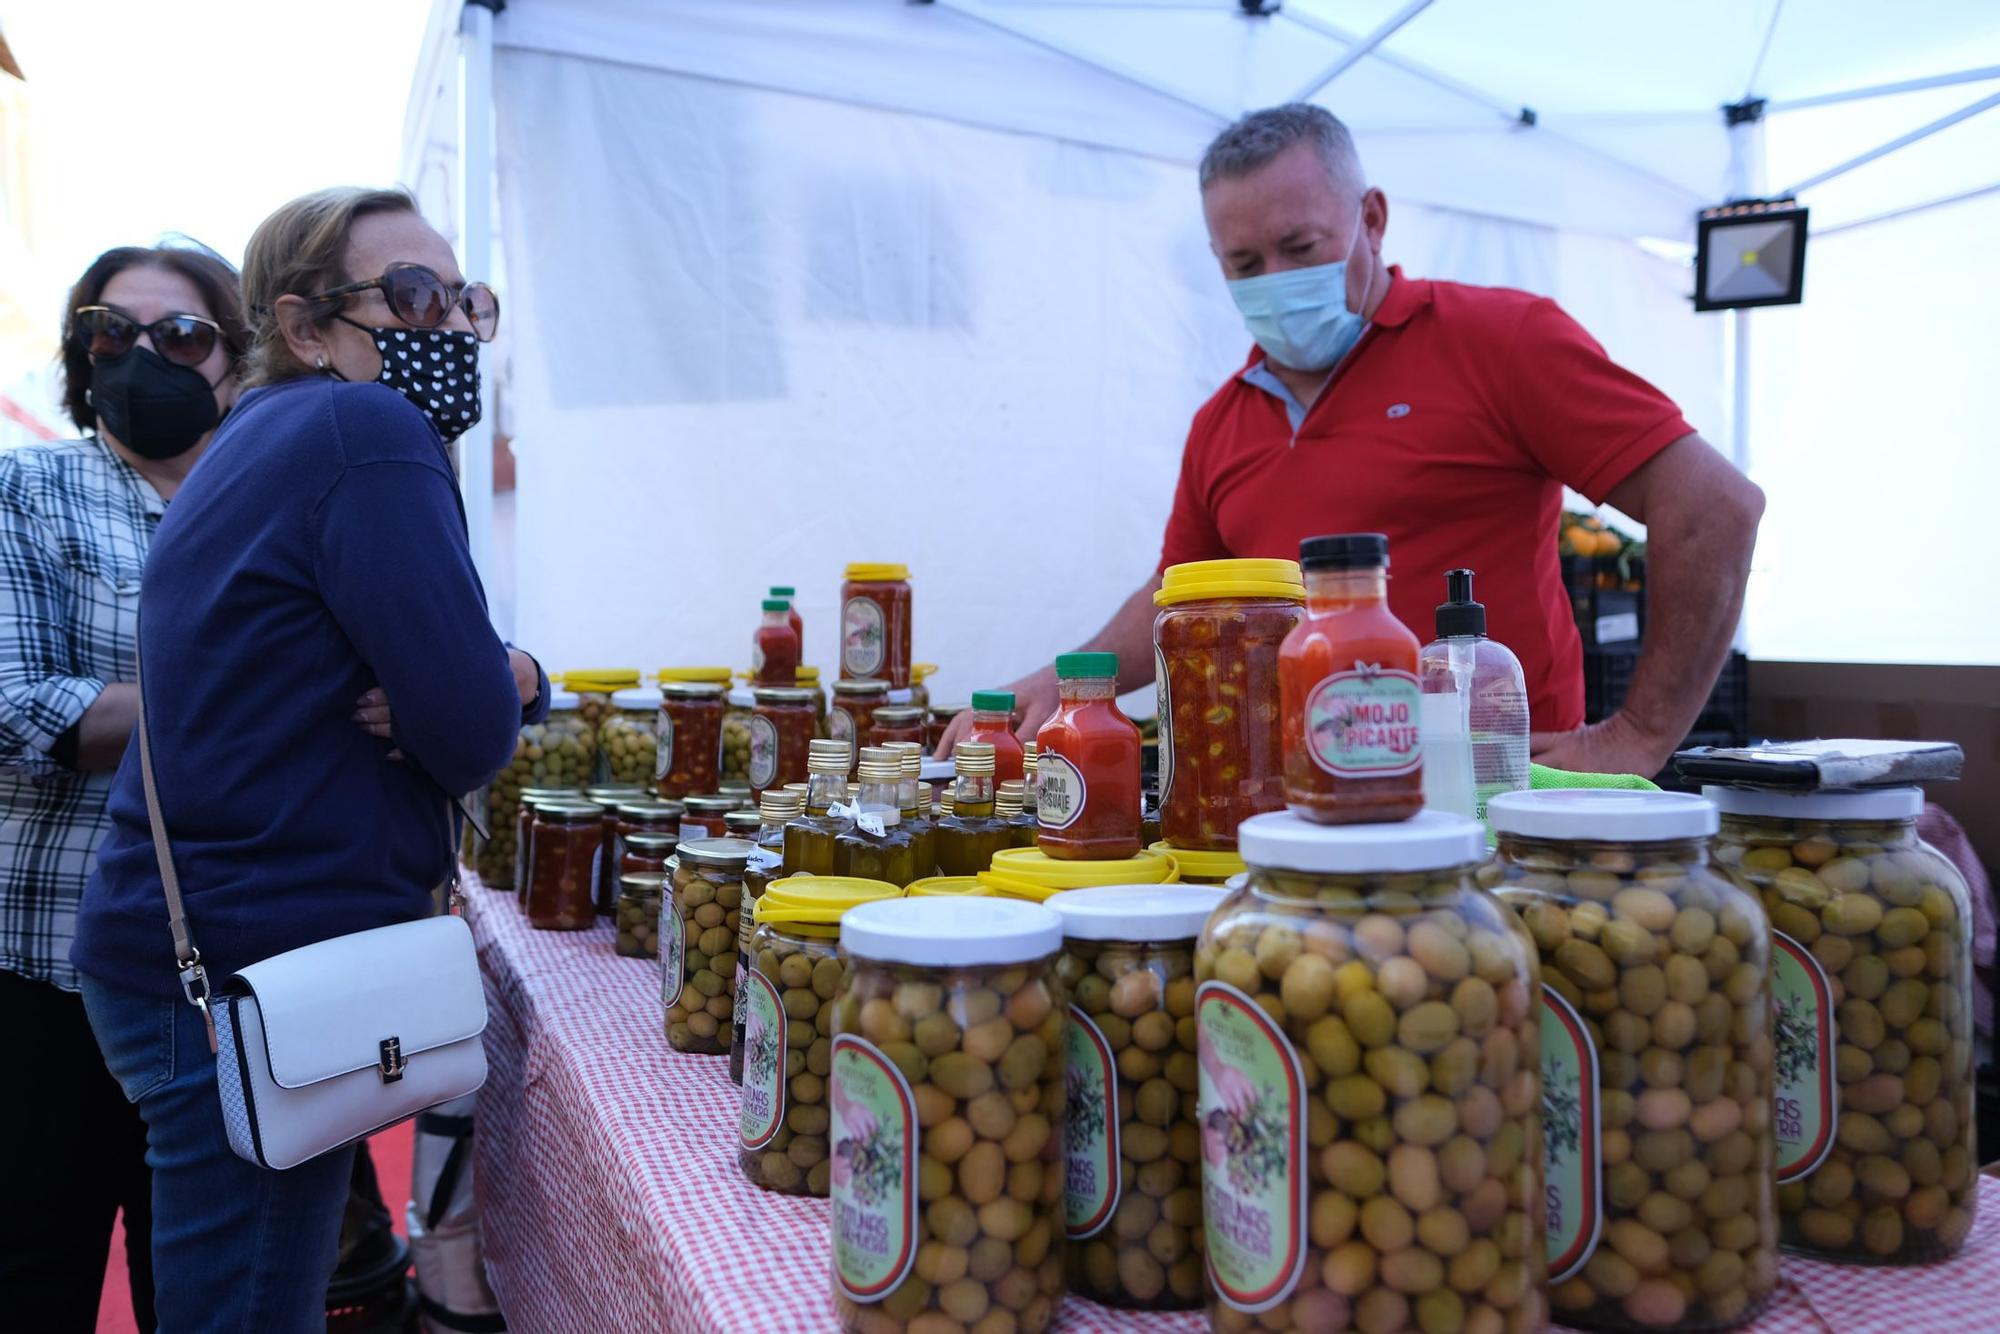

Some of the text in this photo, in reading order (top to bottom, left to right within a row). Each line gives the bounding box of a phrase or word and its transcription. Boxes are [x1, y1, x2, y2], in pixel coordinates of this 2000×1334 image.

[1354, 703, 1409, 724] MOJO
[1346, 726, 1419, 748] PICANTE
[1047, 777, 1067, 794] MOJO
